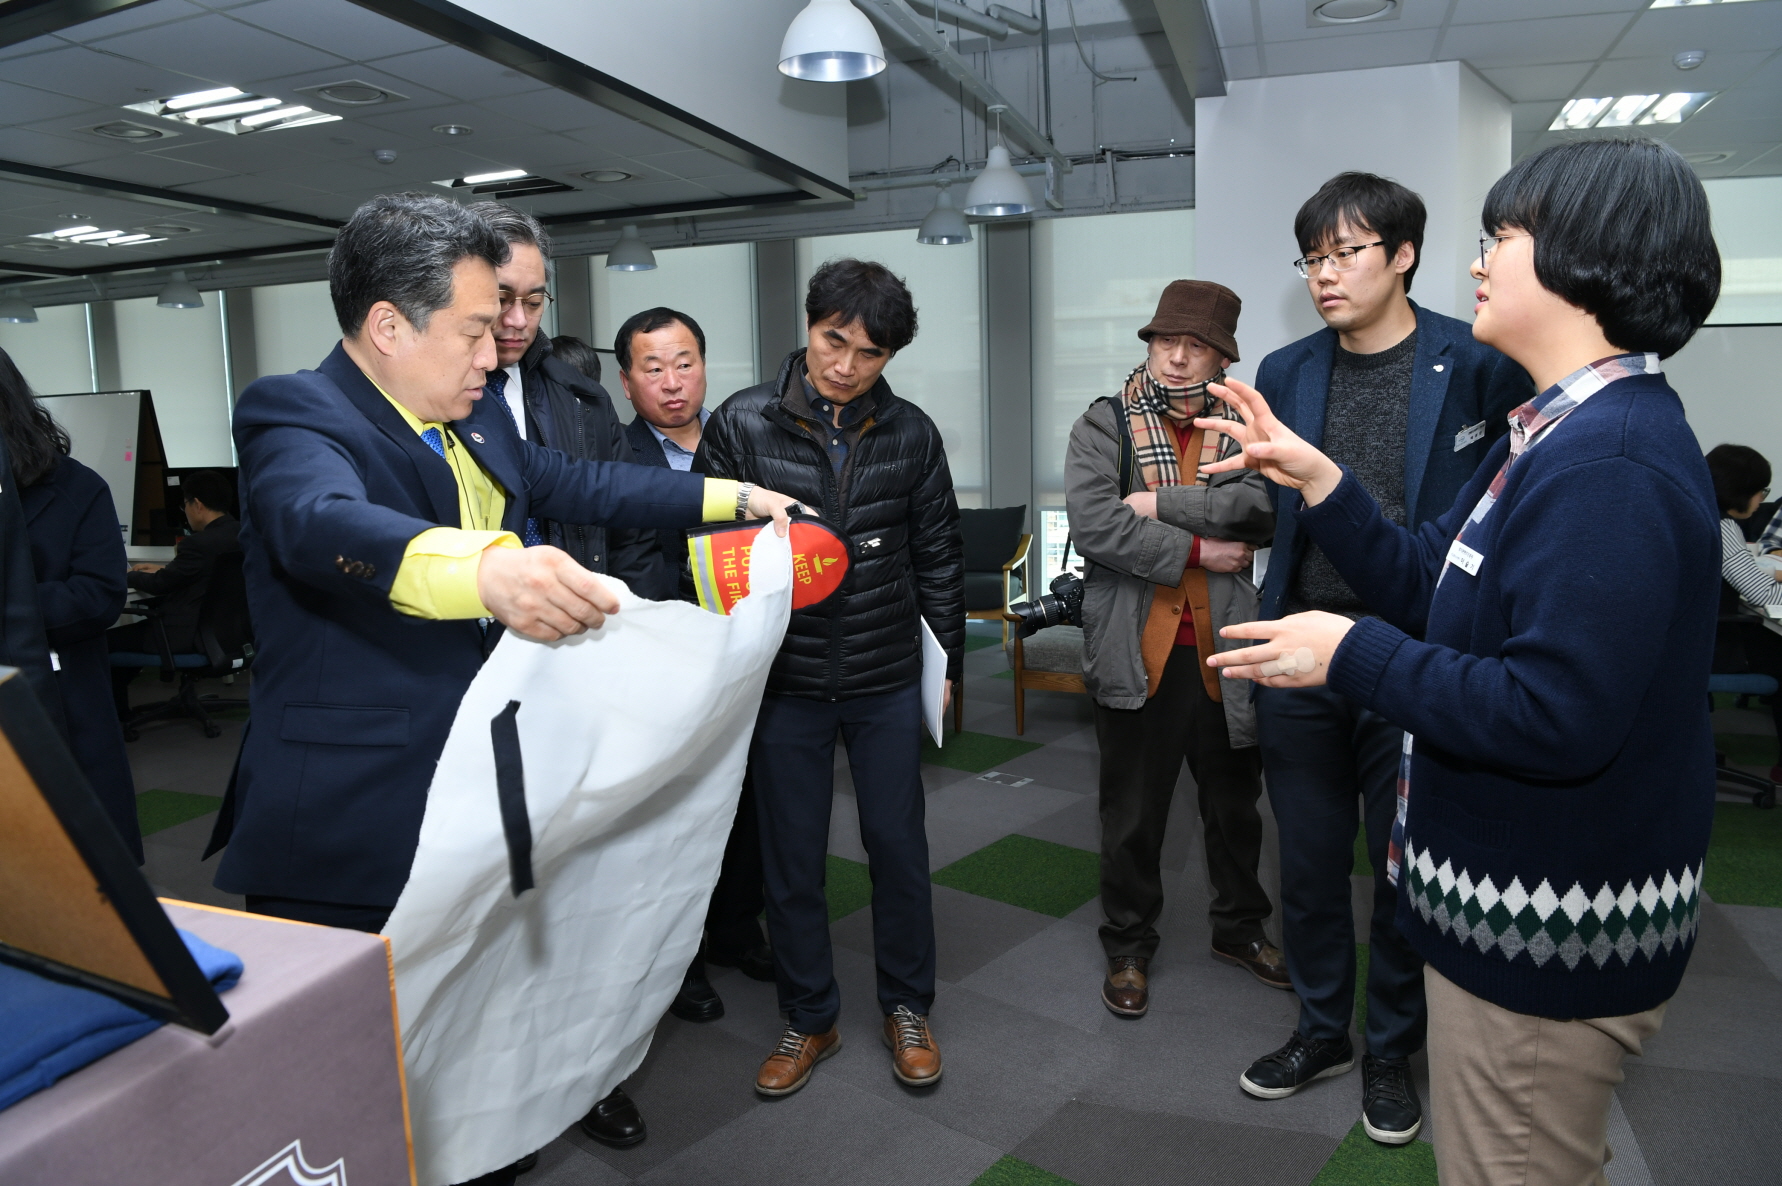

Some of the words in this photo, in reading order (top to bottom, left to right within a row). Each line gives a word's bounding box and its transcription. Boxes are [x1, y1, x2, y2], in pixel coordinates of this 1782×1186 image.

[722, 546, 738, 579] THE
[793, 553, 812, 585] KEEP
[726, 582, 744, 605] FIR
